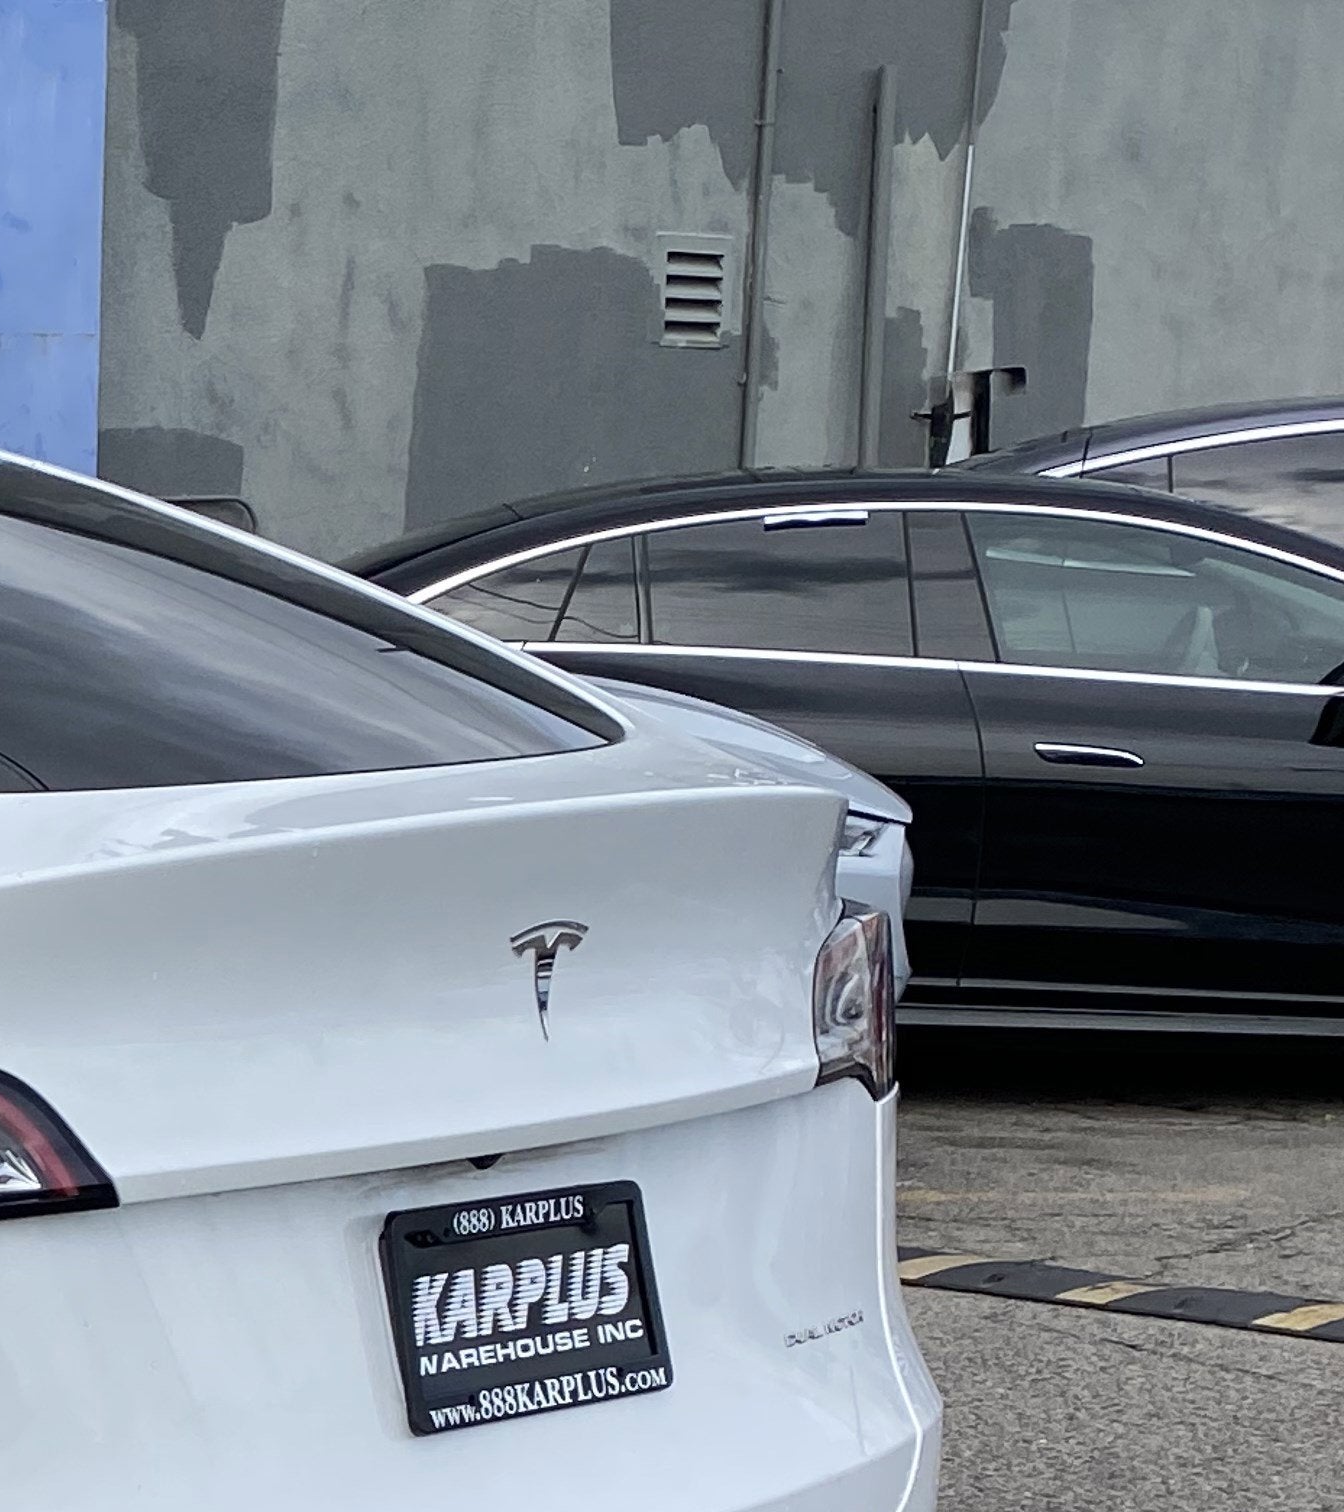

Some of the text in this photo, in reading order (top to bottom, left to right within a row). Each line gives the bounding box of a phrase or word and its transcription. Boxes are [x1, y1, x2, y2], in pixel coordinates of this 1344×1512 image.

[453, 1194, 584, 1235] (888) KARPLUS
[412, 1243, 630, 1347] KARPLUS
[596, 1318, 644, 1344] INC
